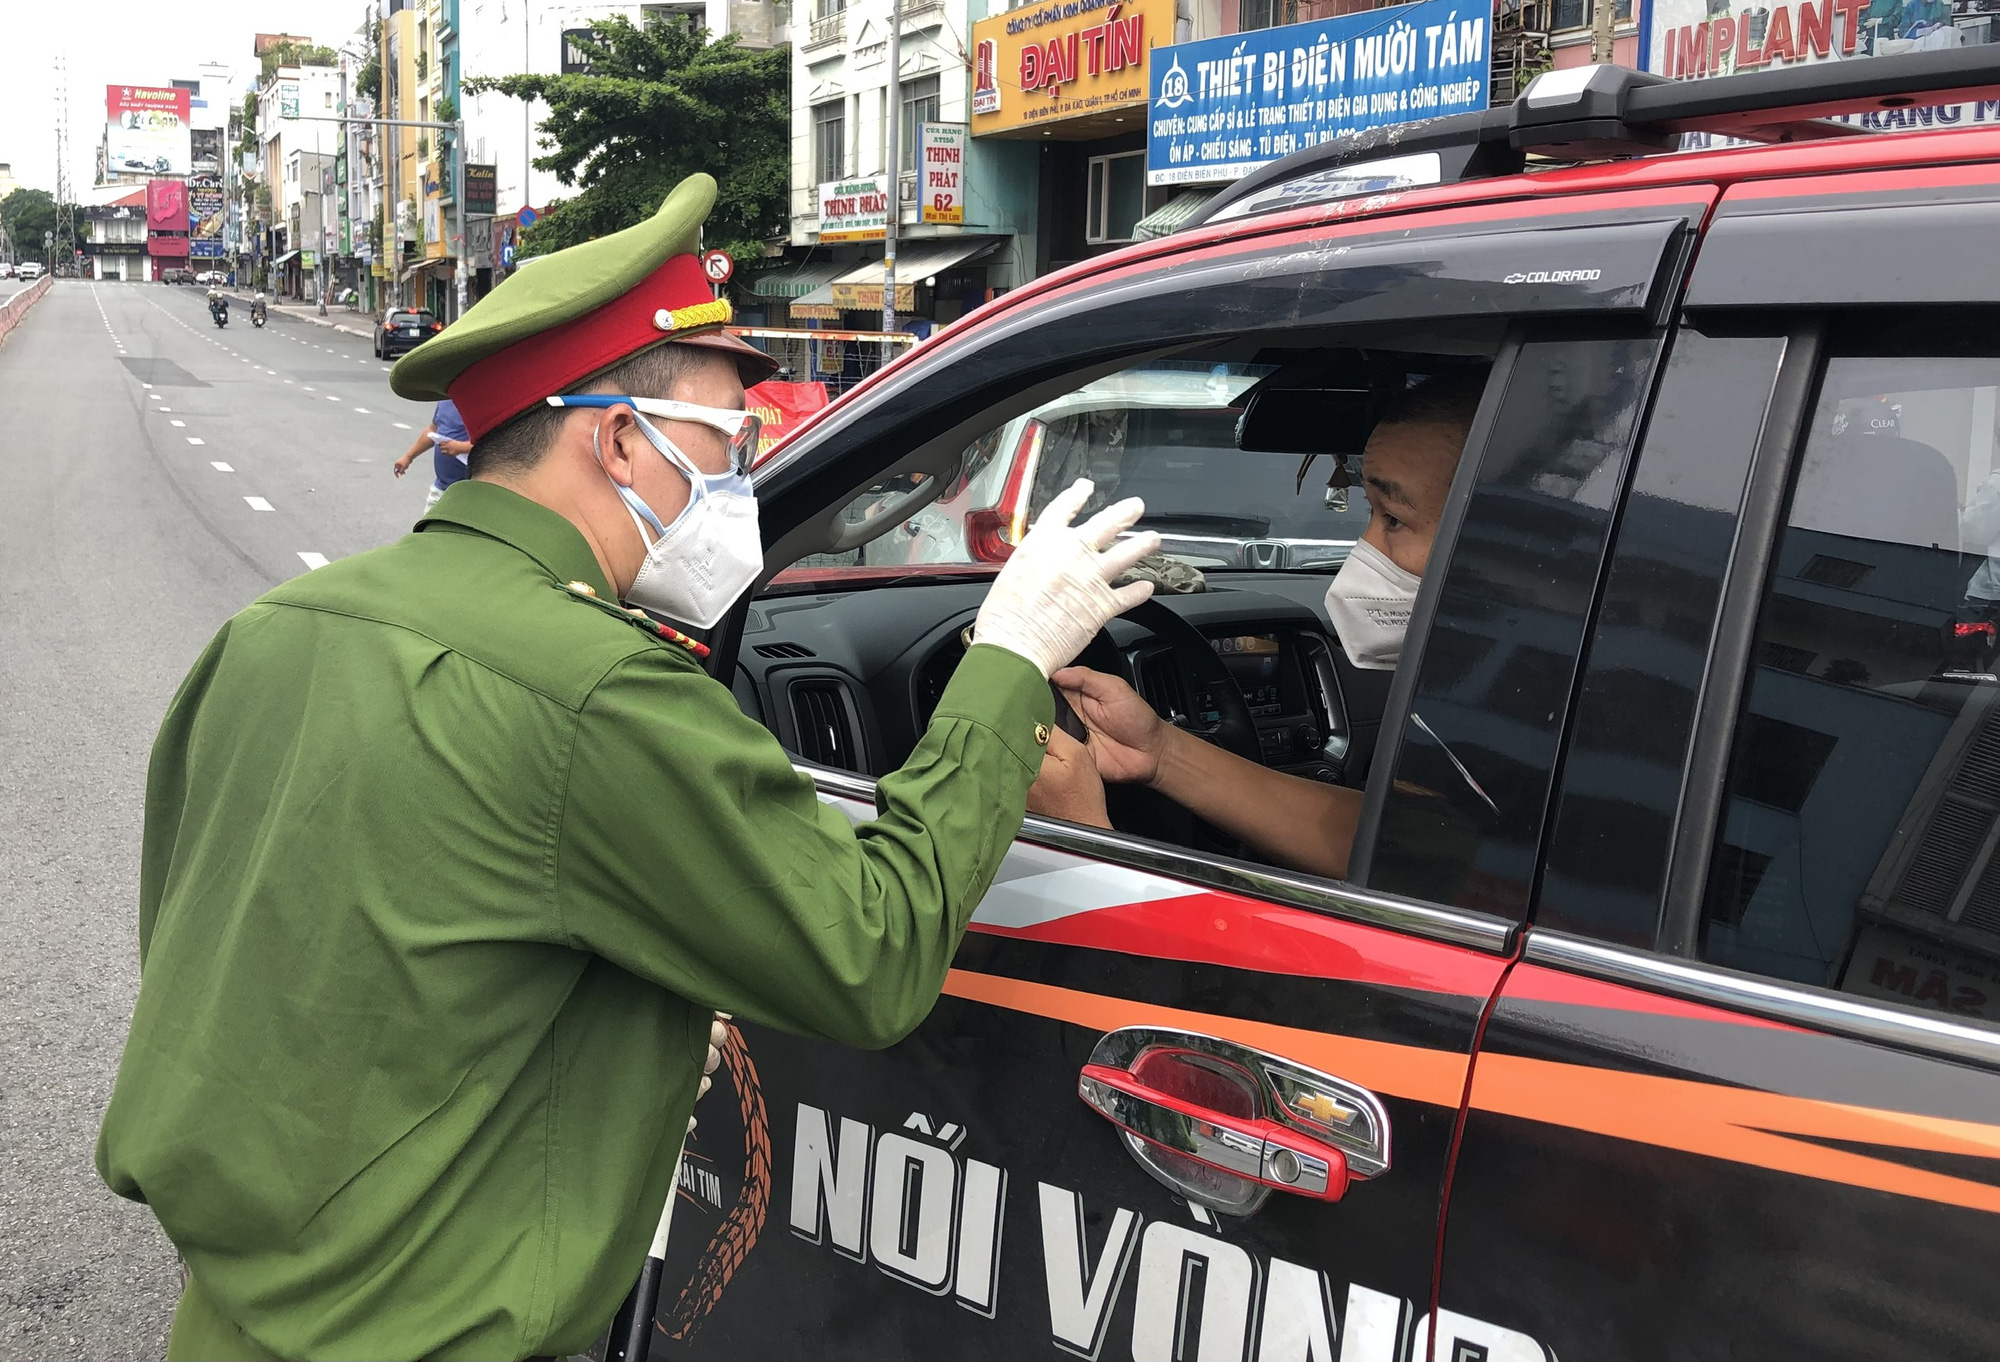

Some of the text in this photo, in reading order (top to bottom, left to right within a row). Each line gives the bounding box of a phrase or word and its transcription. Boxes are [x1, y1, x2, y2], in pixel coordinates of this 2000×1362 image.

[1663, 0, 1871, 79] IMPLANT
[1019, 4, 1143, 98] ĐẠI TÍN
[1197, 10, 1483, 100] THIẾT BỊ ĐIỆN MƯỜI TÁM
[134, 89, 176, 101] Havoline
[1128, 88, 1142, 99] MINH
[1166, 77, 1183, 97] 18
[973, 95, 996, 108] ĐẠI TÍN
[1153, 114, 1185, 138] CHUYÊN:
[1186, 110, 1207, 135] CUNG
[1209, 106, 1225, 131] CẤP
[1237, 111, 1244, 127] &
[1245, 102, 1256, 127] LẺ
[1258, 105, 1286, 125] TRANG
[1288, 95, 1314, 122] THIẾT
[1316, 100, 1327, 121] BỊ
[1328, 94, 1350, 120] ĐIỆN
[1352, 96, 1368, 116] GIA
[1371, 93, 1397, 116] DỤNG
[1400, 92, 1408, 110] &
[1410, 84, 1437, 109] CÔNG
[1440, 76, 1480, 106] NGHIỆP
[1169, 137, 1181, 163] ỔN
[1183, 139, 1194, 161] ÁP
[1201, 132, 1226, 160] CHIẾU
[1228, 134, 1251, 157] SÁNG
[1259, 133, 1271, 155] TỦ
[1274, 129, 1296, 156] ĐIỆN
[1304, 125, 1317, 148] TỦ
[926, 147, 960, 165] THỊNH
[929, 168, 958, 188] PHÁT
[1155, 174, 1166, 183] ĐC:
[1169, 173, 1176, 181] 18
[1177, 168, 1193, 182] ĐIỆN
[1195, 166, 1211, 179] BIÊN
[1234, 168, 1241, 176] P.
[824, 188, 887, 220] THỊNH PHÁT
[934, 193, 953, 212] 62
[925, 212, 937, 220] Mai
[938, 212, 948, 221] Thị
[1526, 269, 1601, 283] COLORADO
[756, 403, 782, 425] SOÁT
[1870, 419, 1896, 428] CLEAR
[697, 1167, 722, 1209] TIM
[790, 1102, 1008, 1319] NỐI
